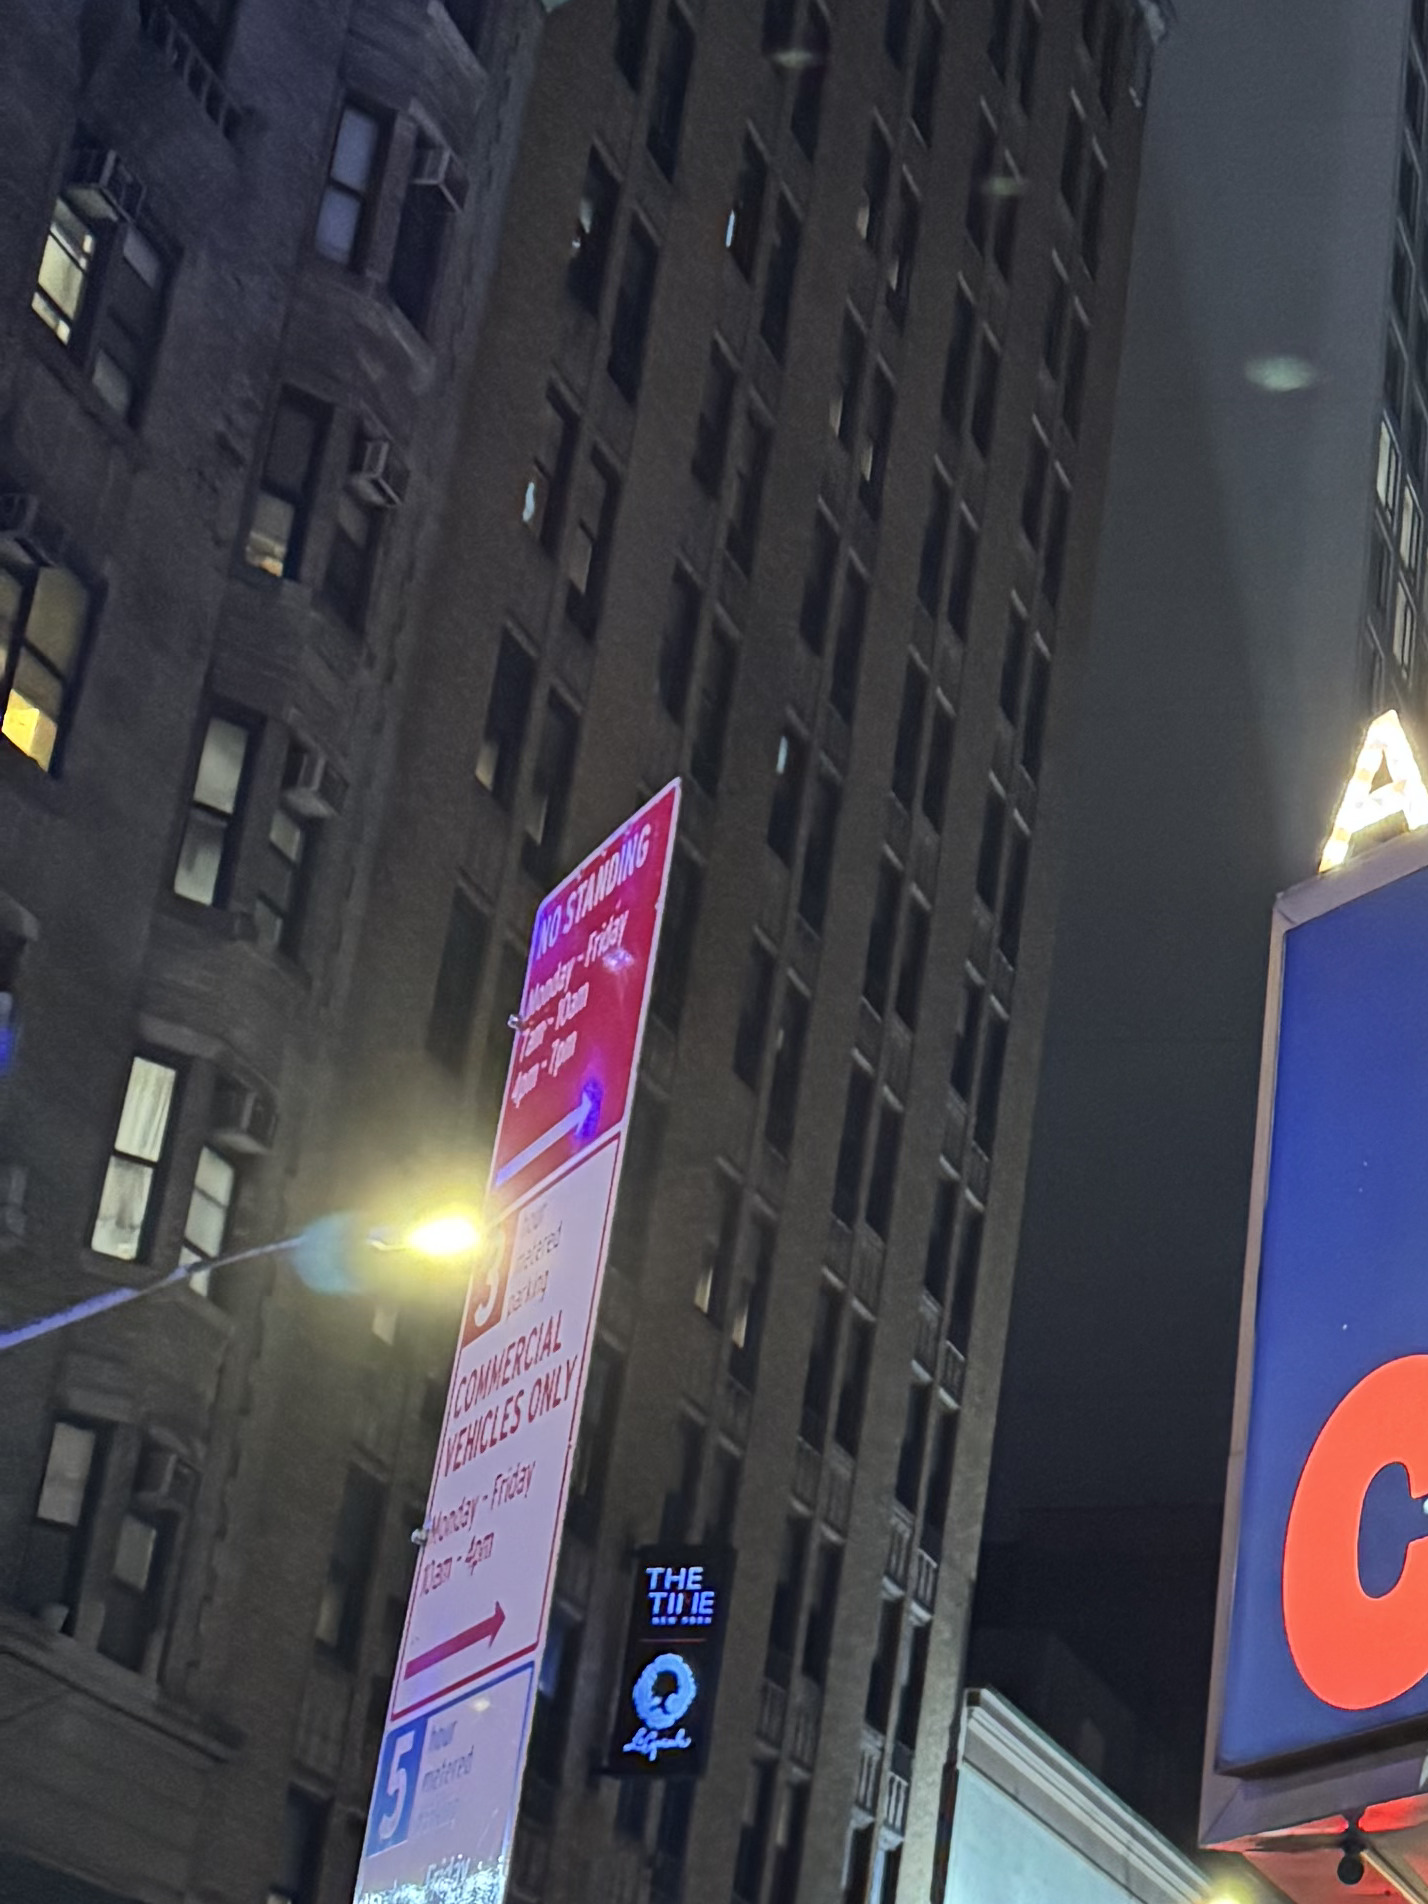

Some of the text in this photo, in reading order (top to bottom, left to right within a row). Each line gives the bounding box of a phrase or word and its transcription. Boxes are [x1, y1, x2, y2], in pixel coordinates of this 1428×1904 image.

[536, 822, 653, 961] NO STANDING
[583, 909, 630, 968] Friday
[474, 1231, 507, 1328] 3
[442, 1353, 579, 1478] VEHICLES ONLY
[451, 1309, 564, 1420] COMMERCIAL
[430, 1494, 481, 1546] Monday
[489, 1460, 537, 1511] Friday
[645, 1566, 705, 1590] THE
[377, 1729, 417, 1841] 5
